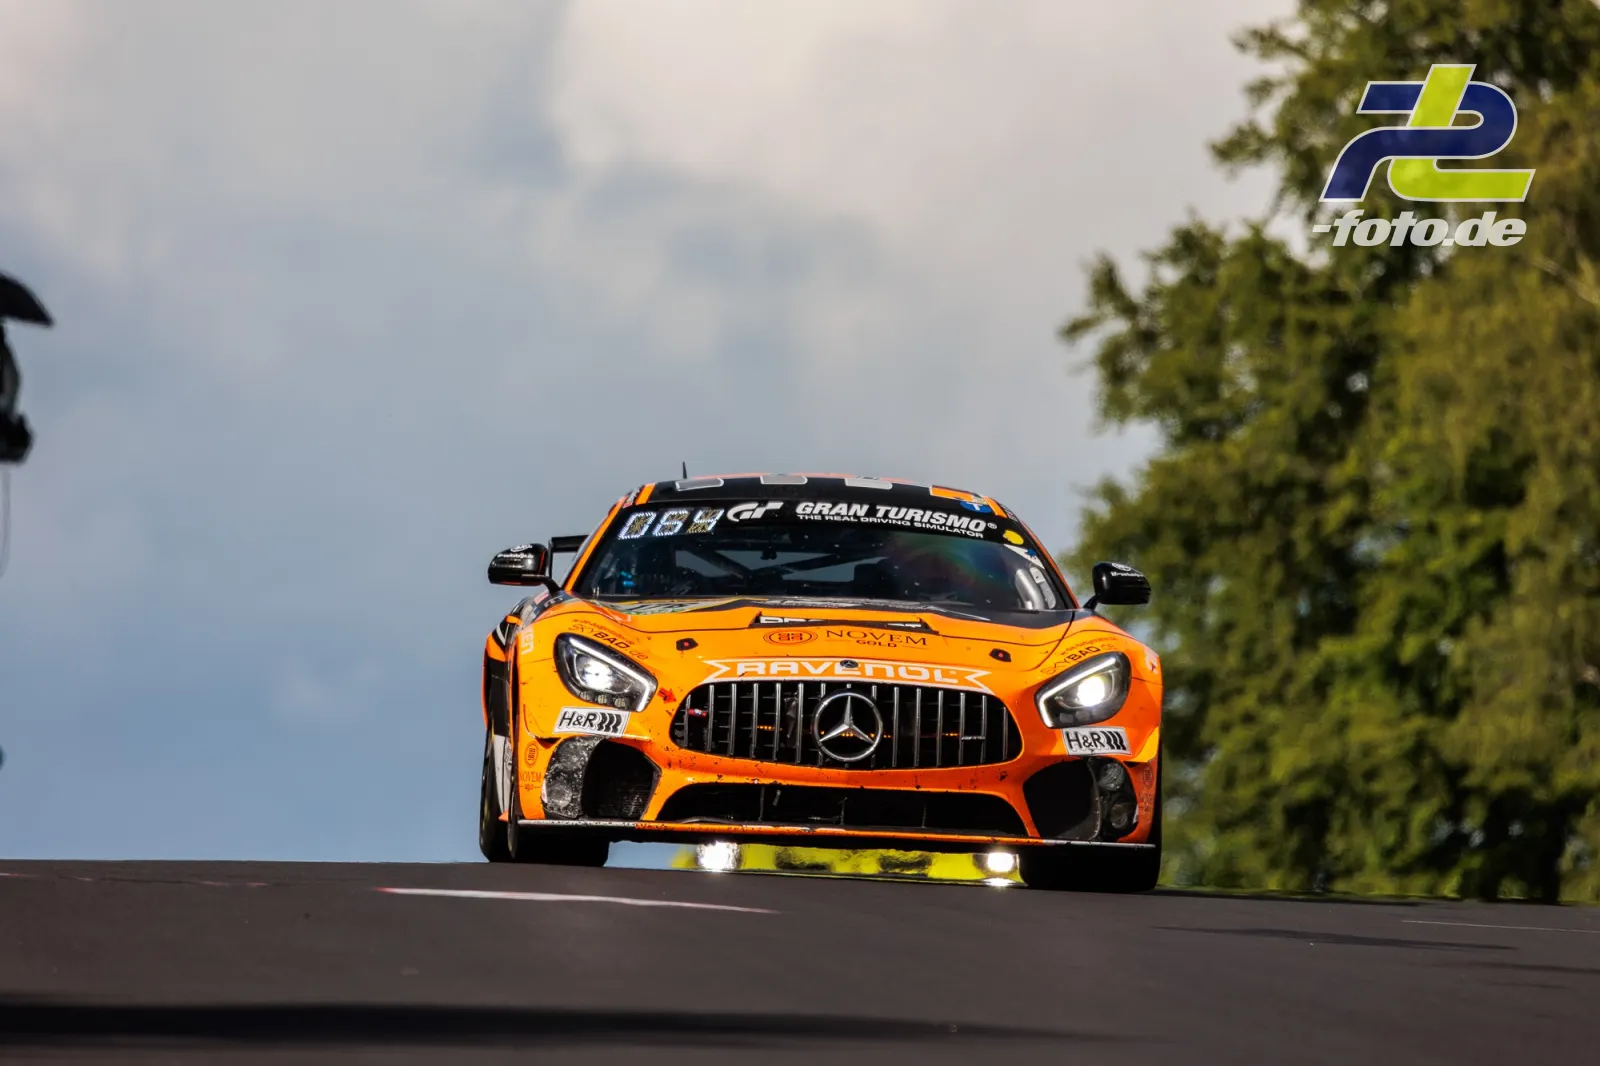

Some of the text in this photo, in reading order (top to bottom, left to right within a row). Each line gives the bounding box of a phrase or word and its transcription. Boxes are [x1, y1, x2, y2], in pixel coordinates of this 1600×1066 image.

[796, 501, 870, 516] GRAN
[825, 515, 858, 523] REAL
[860, 516, 911, 527] DRIVING
[914, 522, 984, 539] SIMULATOR
[826, 629, 928, 646] NOVEM
[856, 639, 897, 648] GOLD
[736, 660, 959, 684] RAVENOL
[558, 710, 598, 730] H&R
[1066, 730, 1105, 750] H&R
